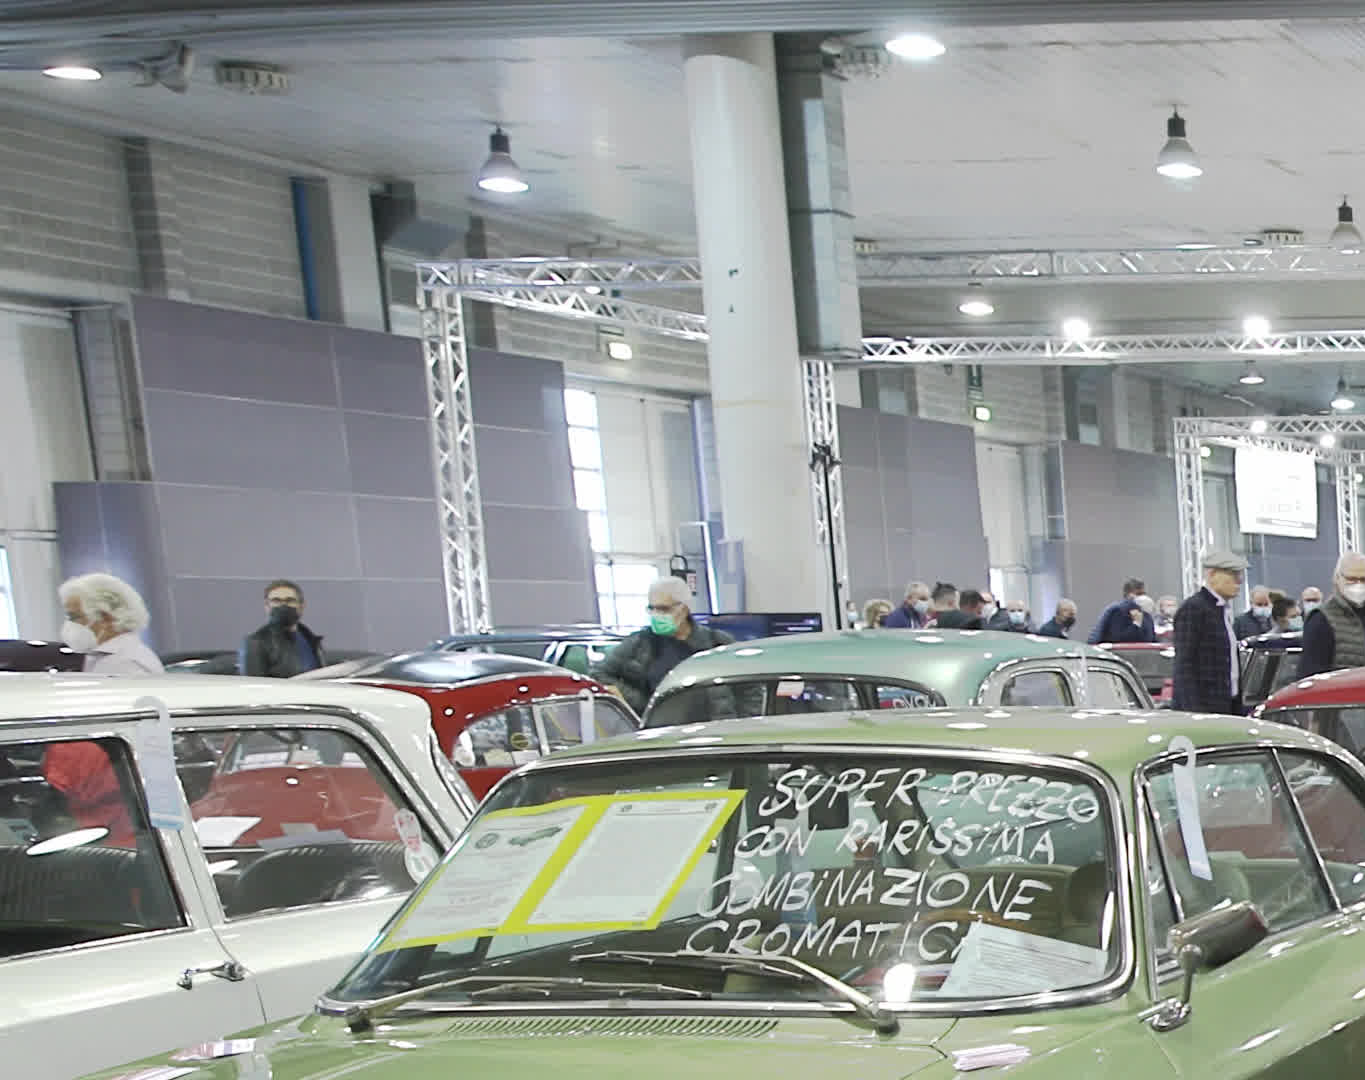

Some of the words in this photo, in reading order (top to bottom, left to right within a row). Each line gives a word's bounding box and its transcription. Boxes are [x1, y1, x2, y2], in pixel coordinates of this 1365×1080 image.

[758, 767, 929, 816] SUPER
[938, 771, 1099, 824] PREZZO
[734, 824, 817, 859] CON
[836, 815, 1055, 865] RARISSIMA
[698, 860, 1053, 921] COMBINAZIONE
